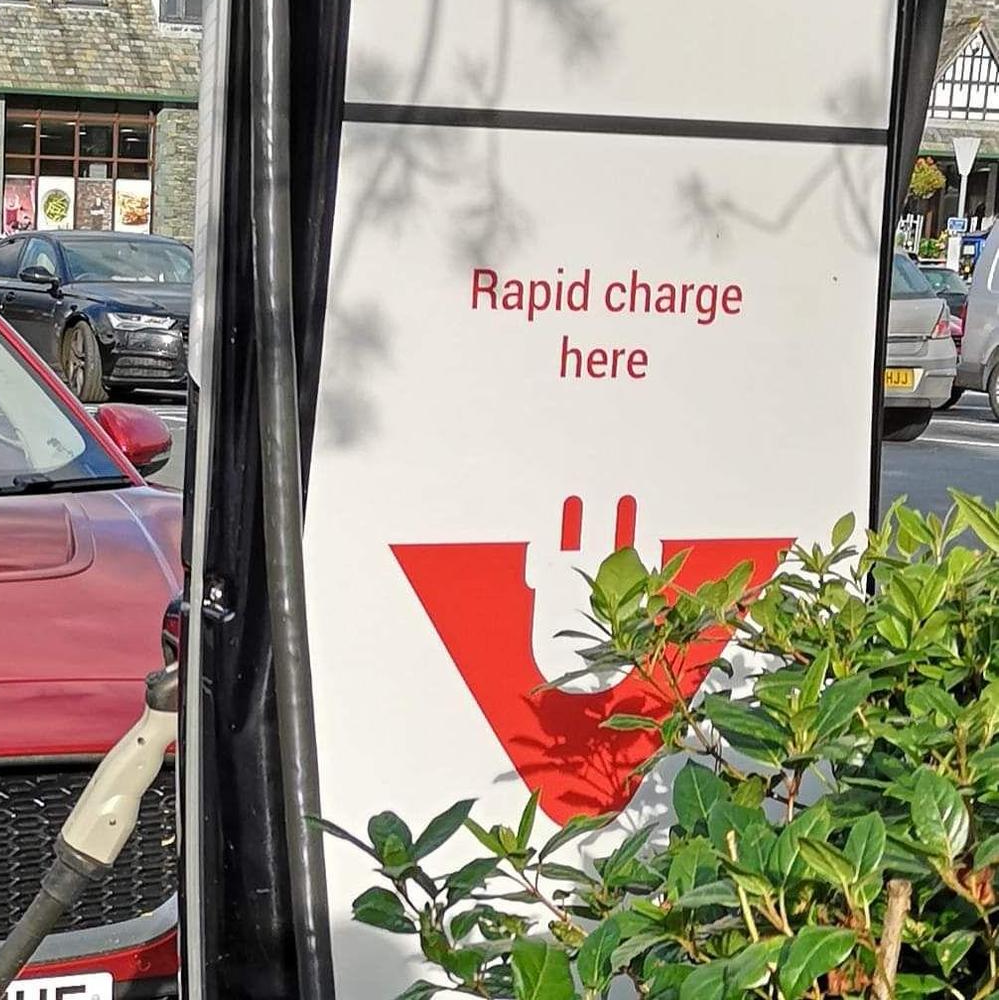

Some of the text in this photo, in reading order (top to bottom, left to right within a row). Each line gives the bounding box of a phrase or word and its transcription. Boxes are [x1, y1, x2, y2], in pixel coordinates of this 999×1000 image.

[471, 267, 744, 326] Rapid charge
[559, 334, 650, 380] here
